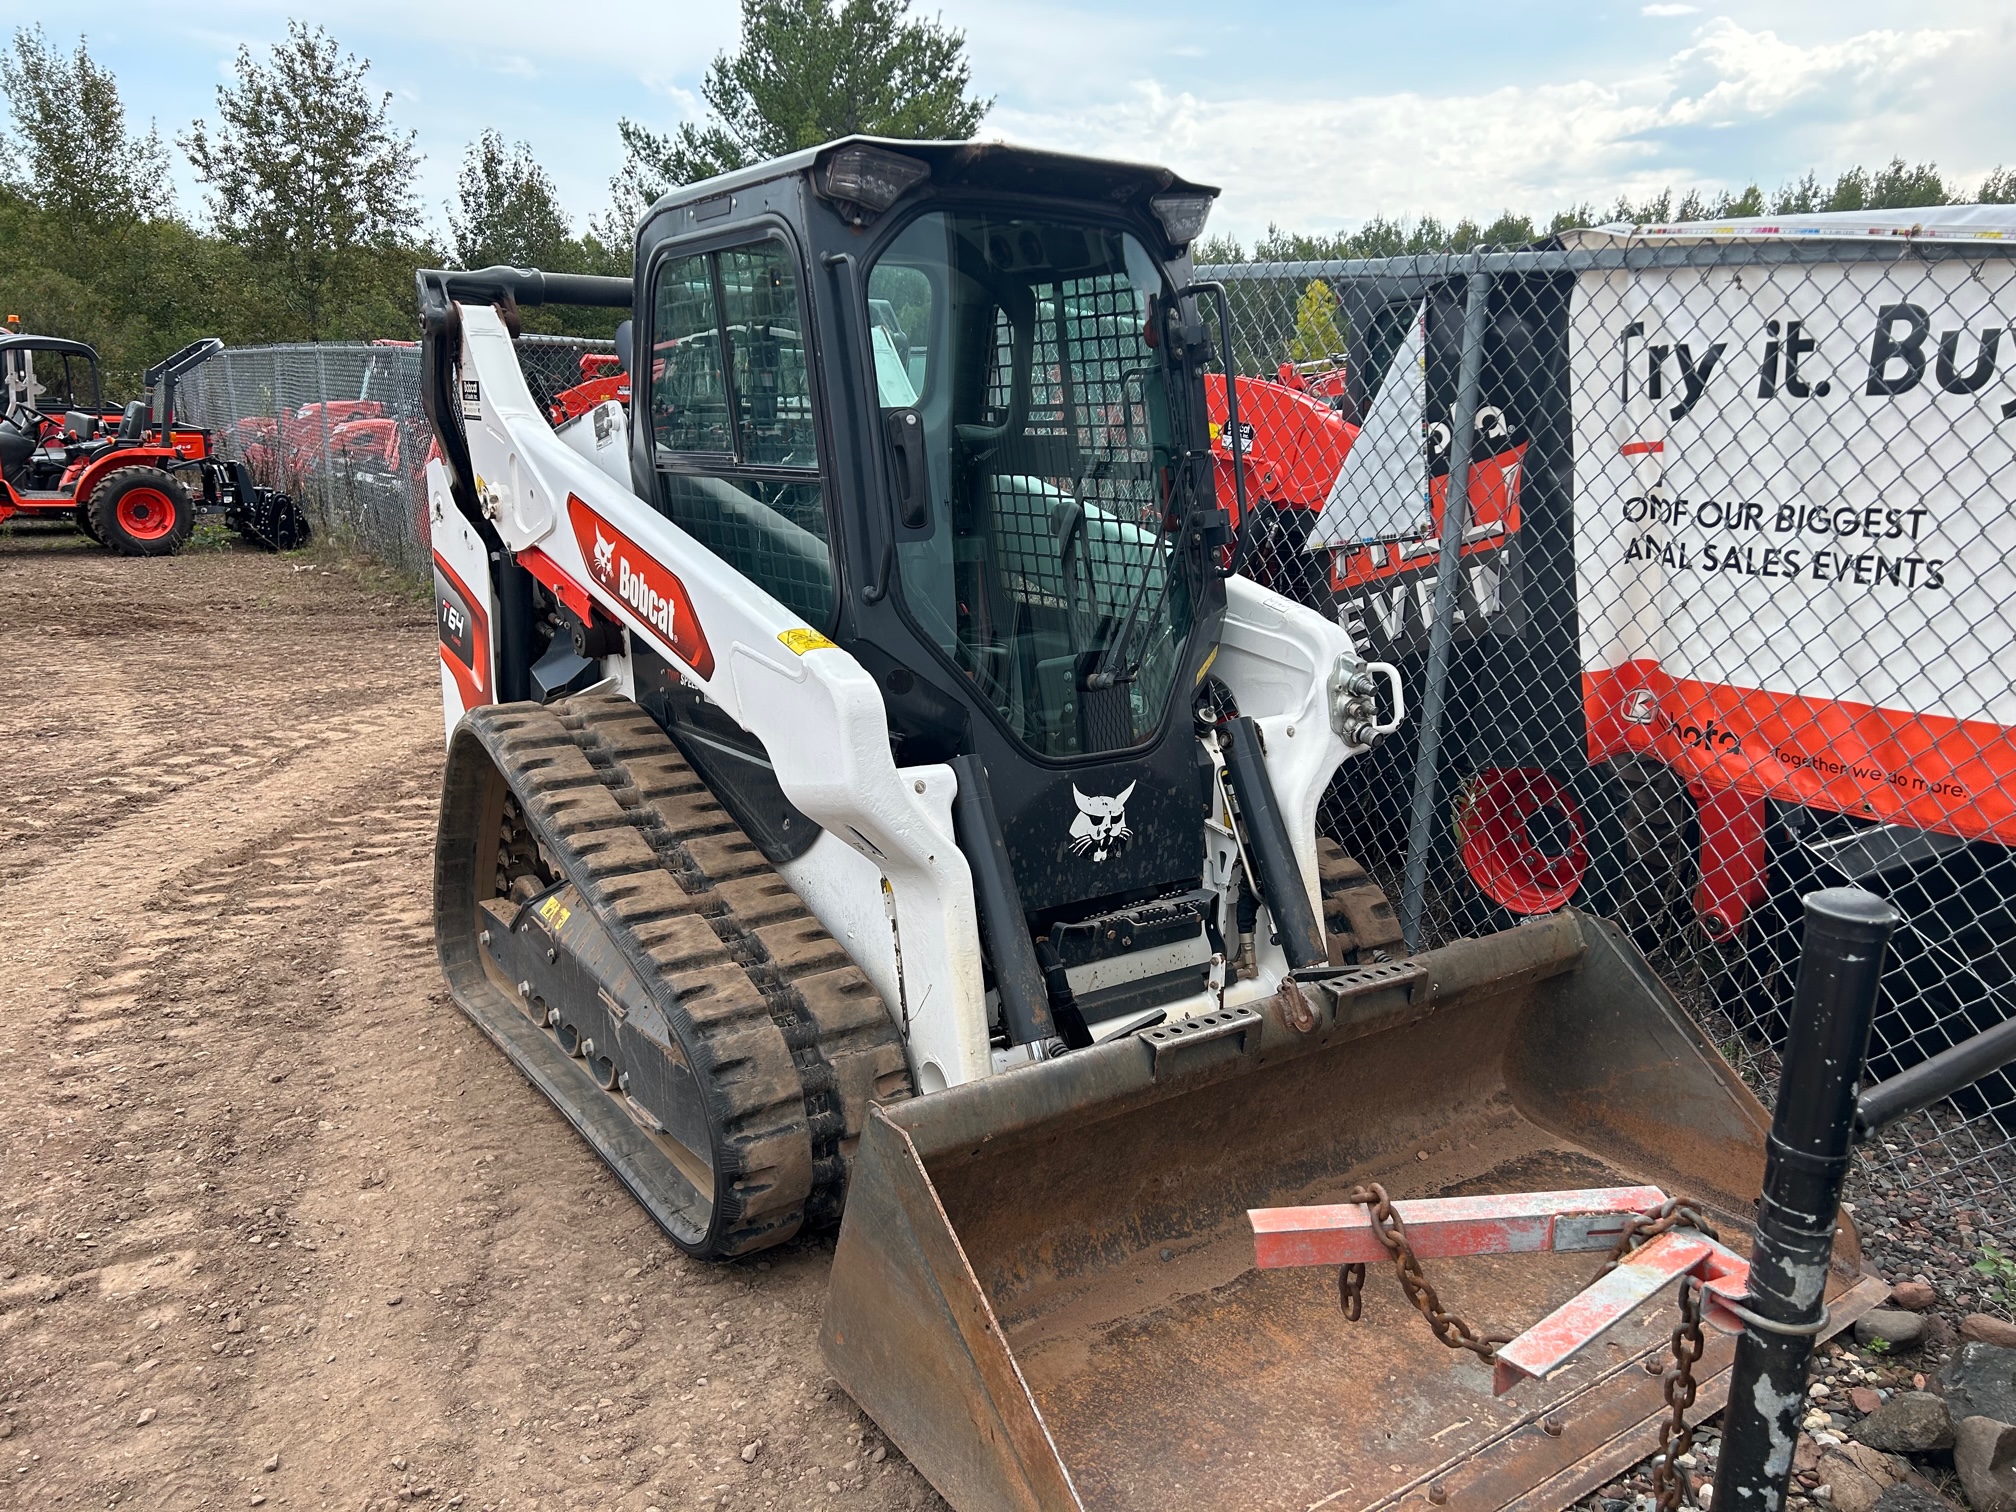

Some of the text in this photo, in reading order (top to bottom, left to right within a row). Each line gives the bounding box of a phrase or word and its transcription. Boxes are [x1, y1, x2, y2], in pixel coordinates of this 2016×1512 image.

[1757, 318, 1831, 400] it.
[1865, 302, 2016, 420] Bu
[1696, 500, 1763, 531] OUR
[1774, 504, 1928, 540] BIGGEST
[1702, 543, 1800, 578] SALES
[1812, 550, 1945, 590] EVENTS
[442, 599, 465, 638] T64
[619, 555, 676, 641] Bobcat
[1773, 747, 1968, 799] Together we do more.
